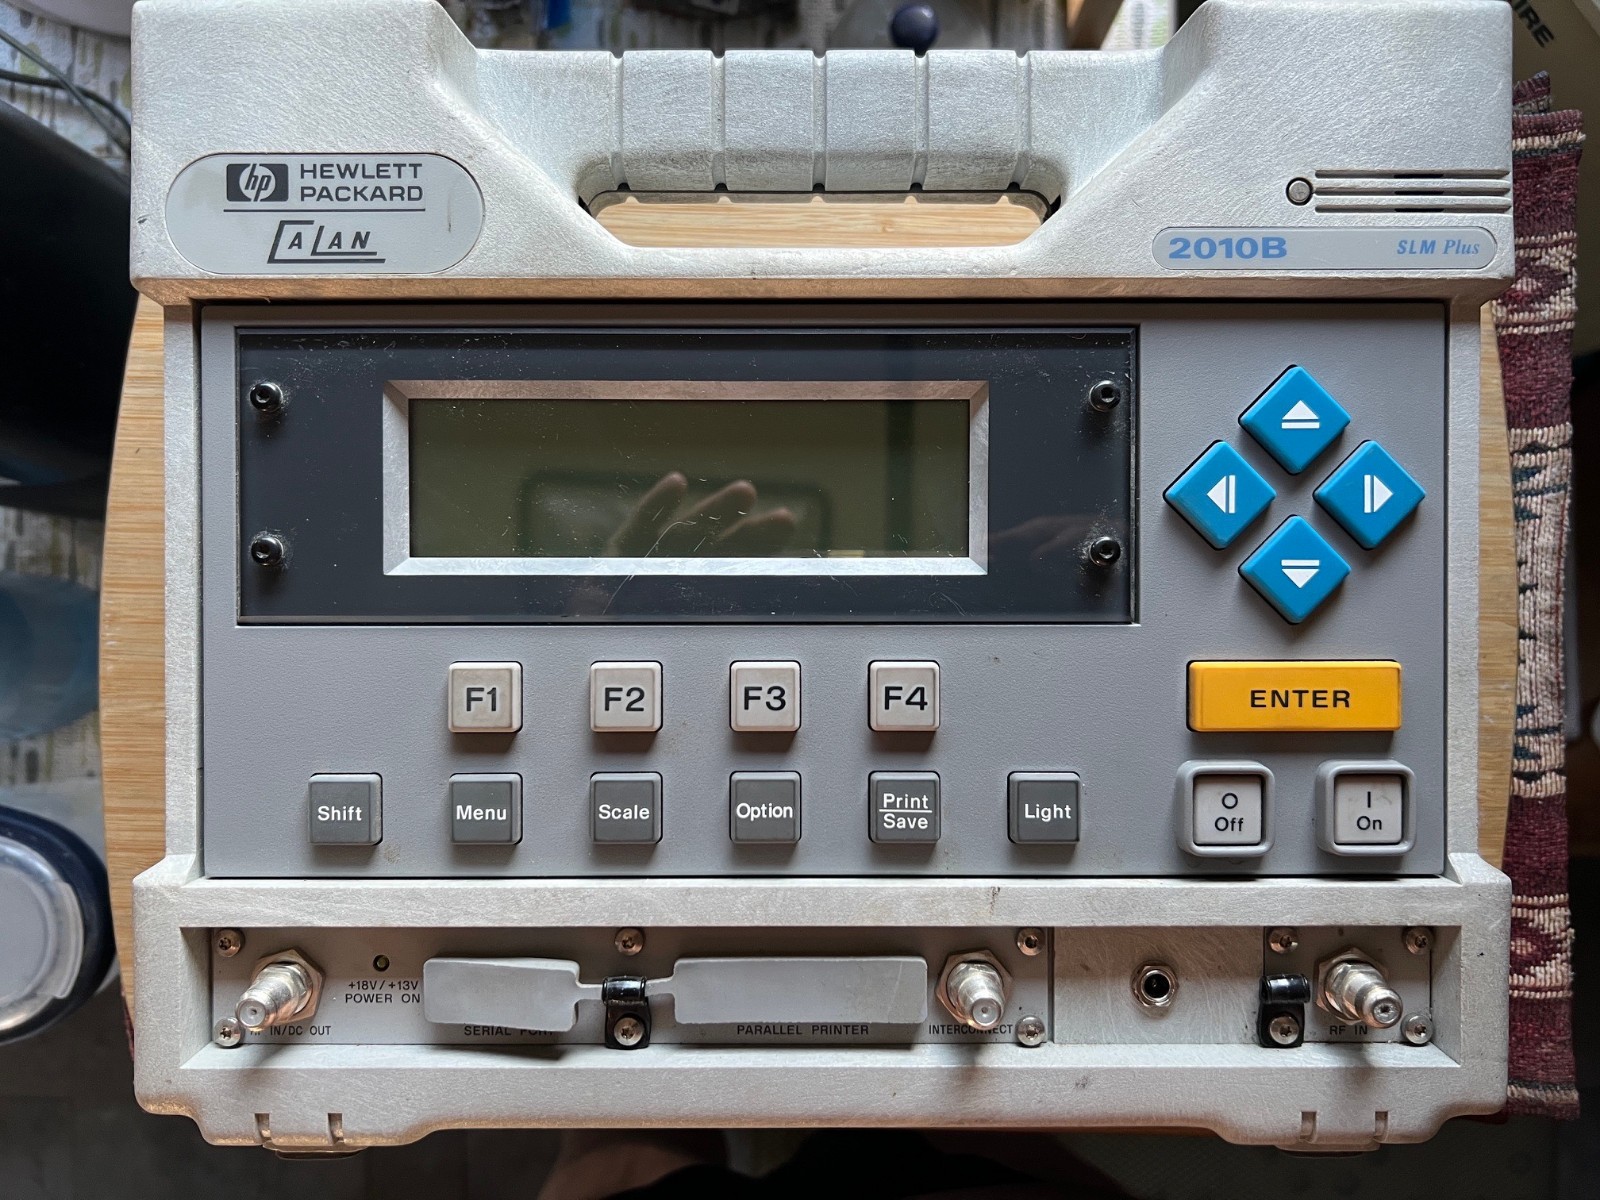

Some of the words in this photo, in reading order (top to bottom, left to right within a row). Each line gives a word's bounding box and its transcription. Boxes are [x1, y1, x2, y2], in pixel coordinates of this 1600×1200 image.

[300, 164, 422, 179] HEWLETT
[301, 186, 422, 201] PACKARD
[1168, 237, 1287, 259] 2010B
[1396, 240, 1436, 255] SLM
[1443, 239, 1479, 255] Plus
[466, 687, 497, 711] F1
[604, 687, 645, 711] F2
[743, 686, 786, 711] F3
[884, 686, 928, 710] F4
[1250, 690, 1350, 708] ENTER
[883, 793, 929, 809] Print
[317, 806, 362, 821] Shift
[456, 805, 507, 820] Menu
[598, 804, 650, 820] Scale
[736, 802, 793, 821] Option
[1024, 803, 1072, 822] Light
[883, 813, 928, 829] Save
[1214, 816, 1244, 832] Off
[1356, 815, 1382, 831] On
[345, 993, 393, 1003] POWER
[401, 993, 420, 1003] ON
[270, 1025, 303, 1036] IN/DC
[309, 1025, 332, 1036] OUT
[464, 1025, 512, 1036] SERIAL
[737, 1024, 802, 1035] PARALLEL
[811, 1024, 869, 1035] PRINTER
[1329, 1025, 1346, 1035] RF
[1354, 1024, 1368, 1035] IN
